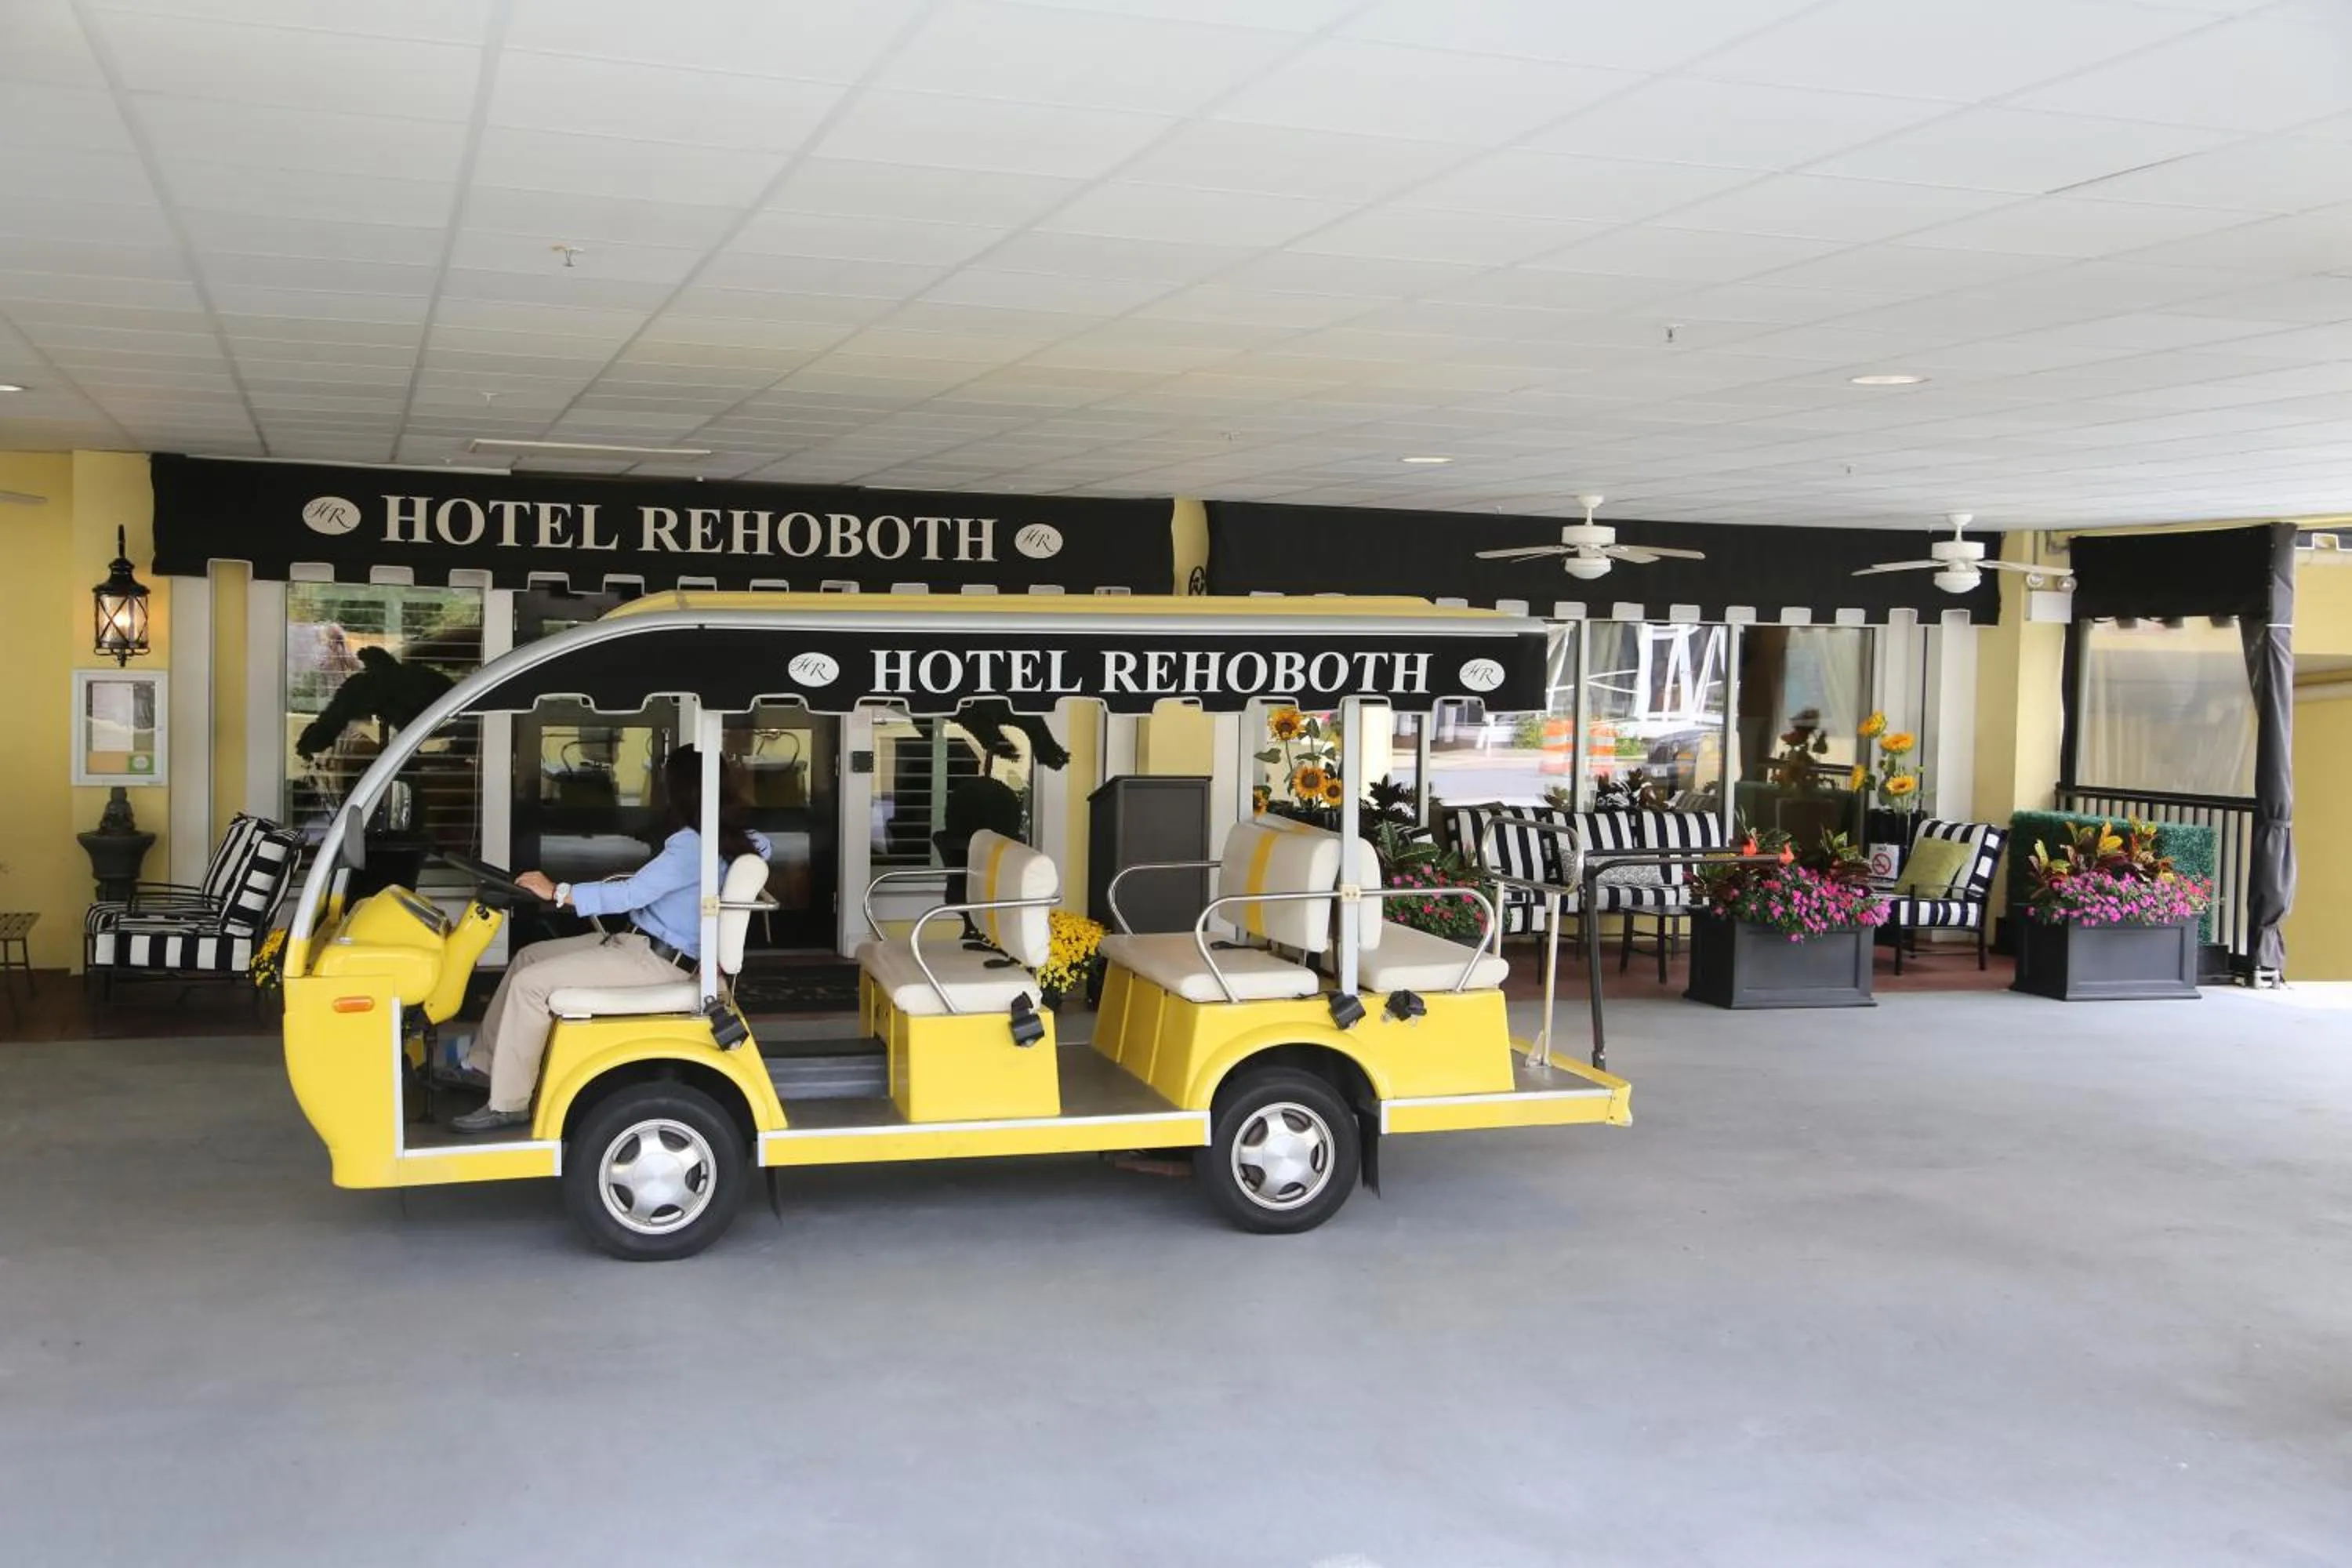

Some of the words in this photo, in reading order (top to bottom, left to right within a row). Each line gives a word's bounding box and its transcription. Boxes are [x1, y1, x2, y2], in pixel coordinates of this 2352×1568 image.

[382, 495, 618, 550] HOTEL
[638, 507, 997, 561] REHOBOTH
[869, 650, 1083, 693] HOTEL
[1100, 651, 1433, 694] REHOBOTH
